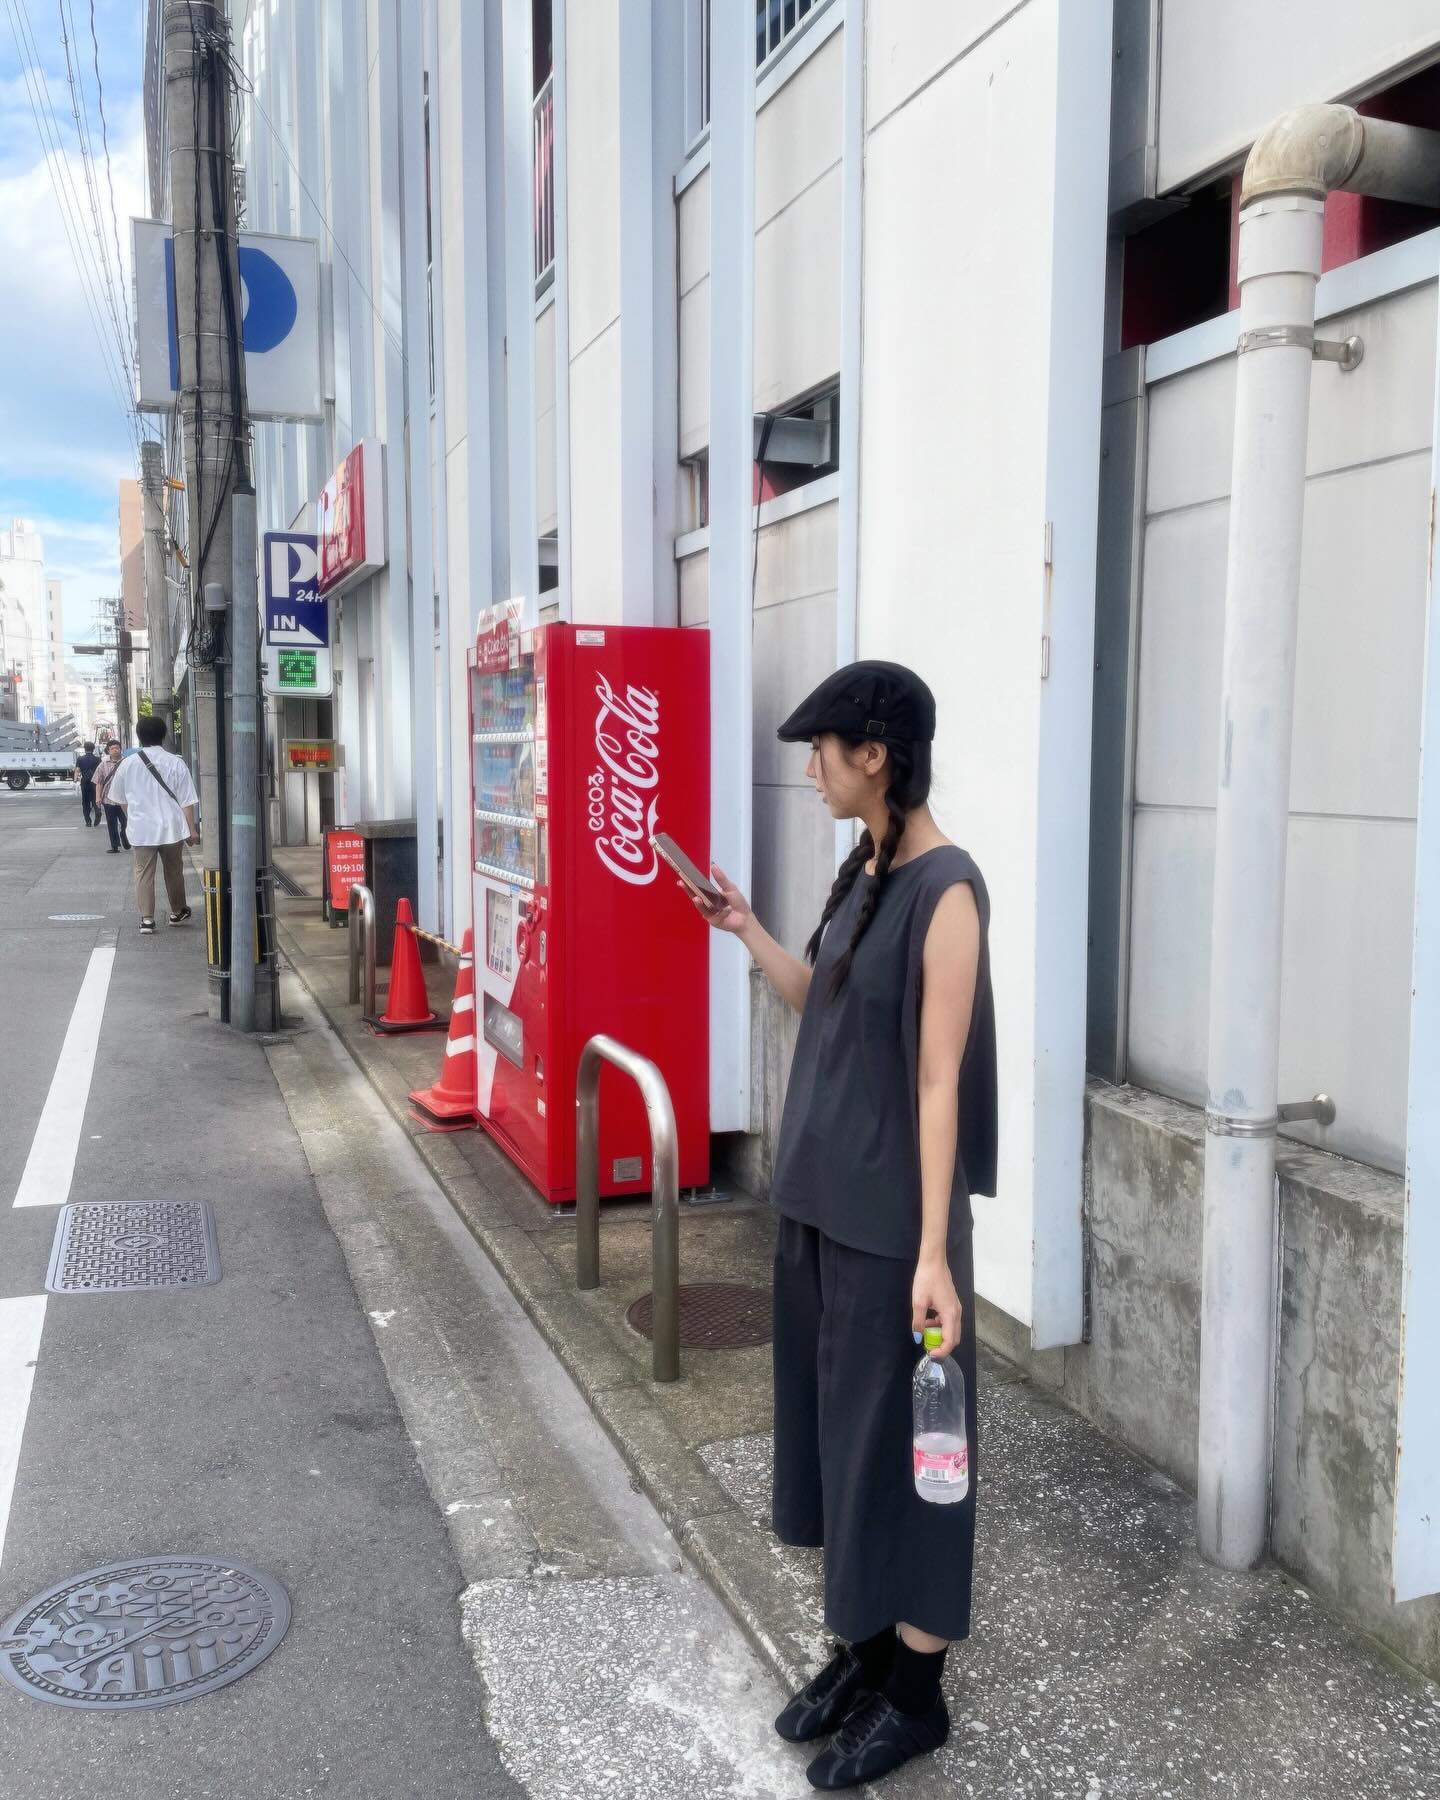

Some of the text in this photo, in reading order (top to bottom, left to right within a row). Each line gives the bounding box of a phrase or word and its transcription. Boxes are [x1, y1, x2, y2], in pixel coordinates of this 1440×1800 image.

[270, 541, 319, 598] P
[273, 614, 296, 630] IN
[279, 650, 318, 688] 空
[595, 670, 659, 886] Coca-Cola
